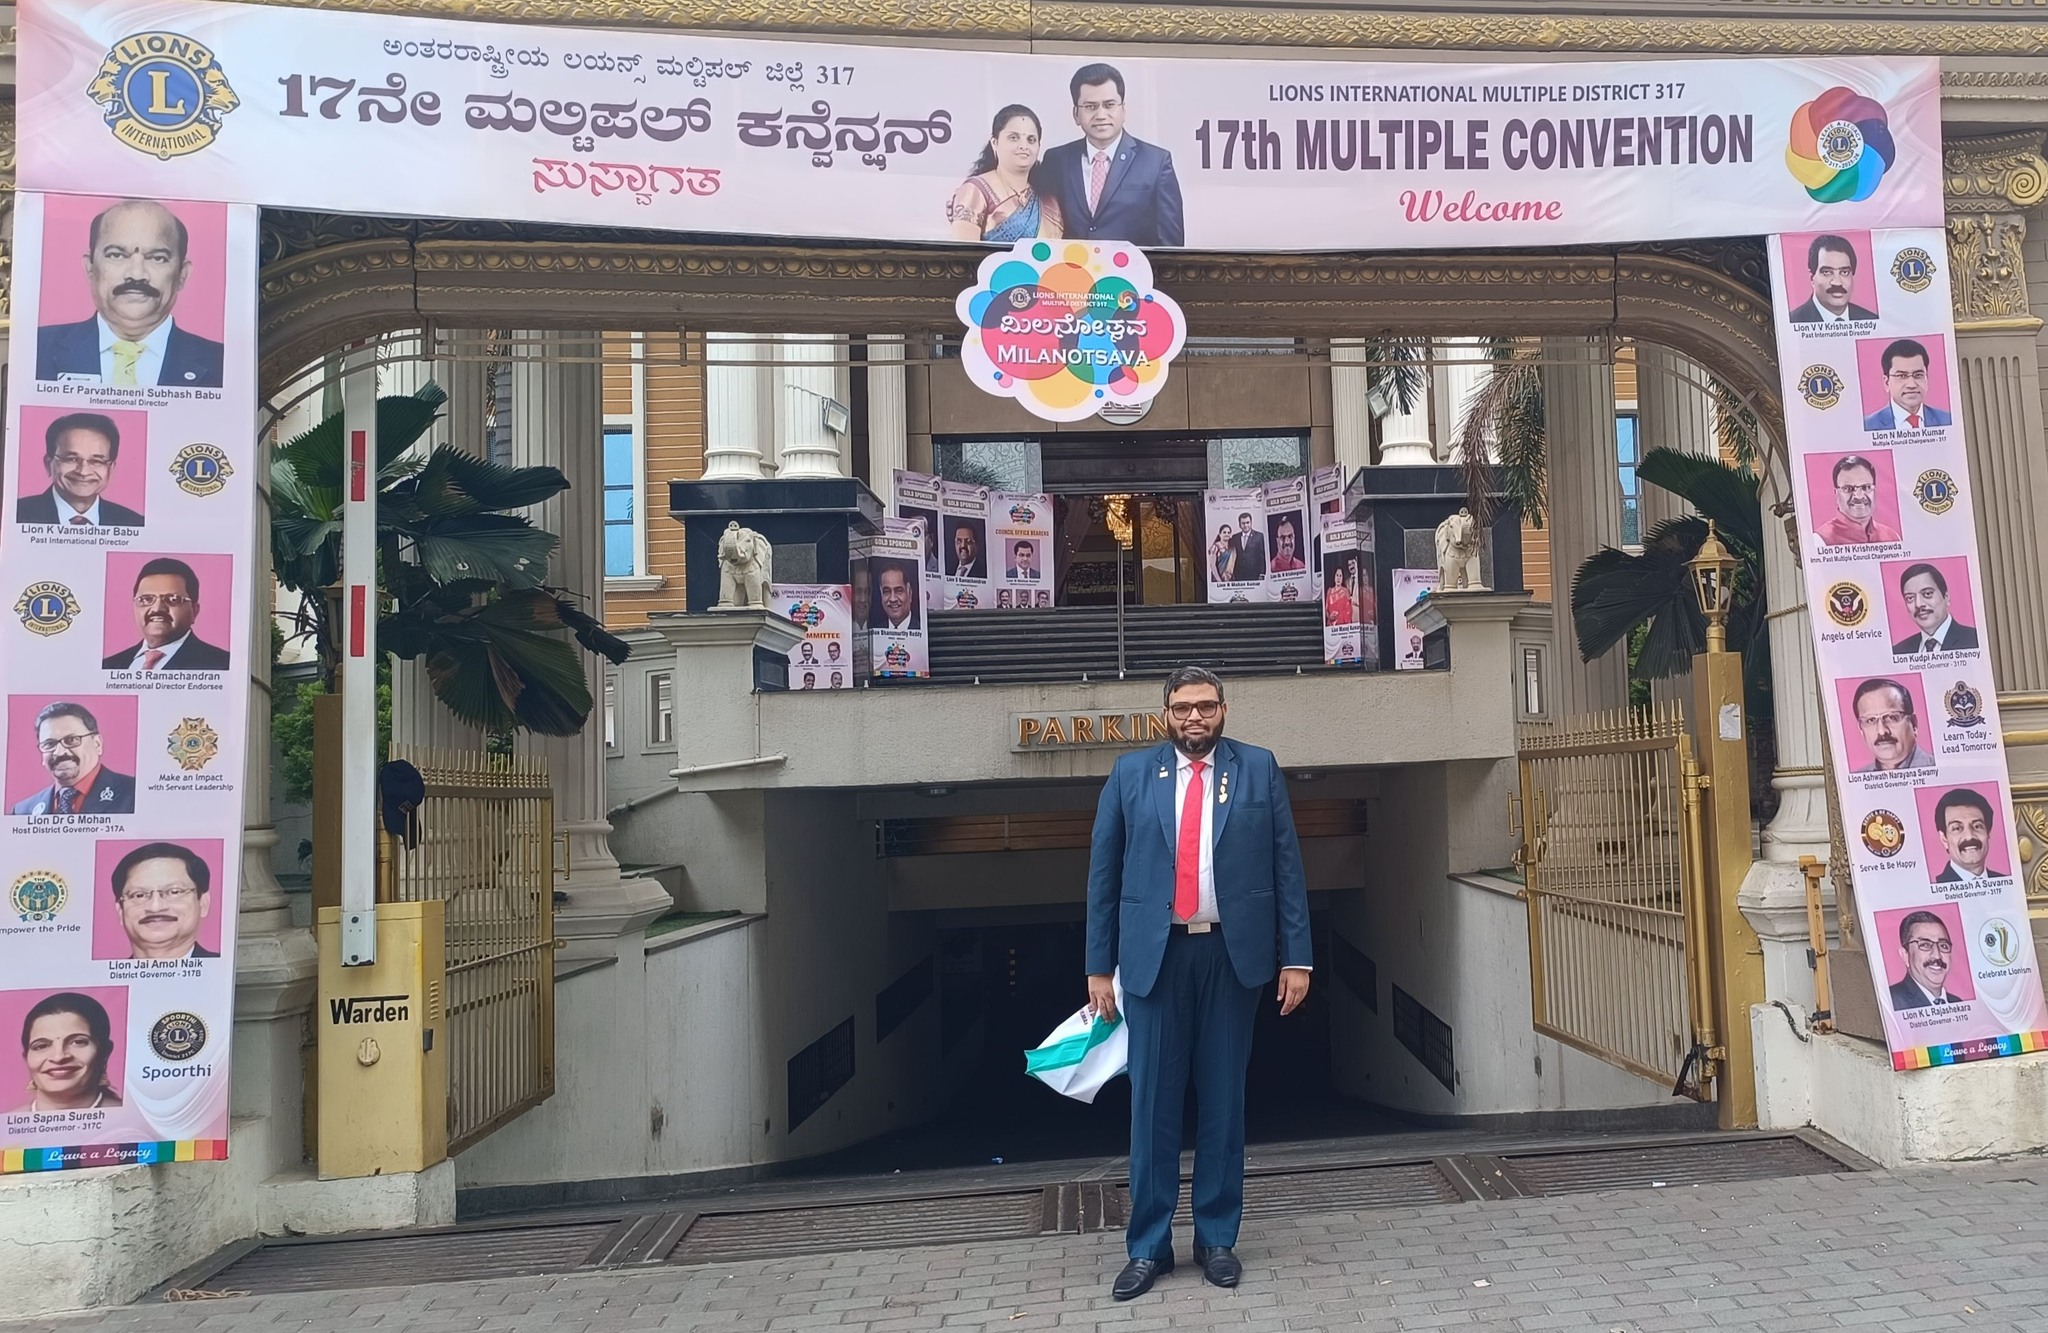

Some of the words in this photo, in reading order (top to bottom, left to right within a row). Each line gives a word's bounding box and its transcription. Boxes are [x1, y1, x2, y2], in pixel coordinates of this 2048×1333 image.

[120, 36, 206, 65] LIONS
[383, 38, 549, 78] ಅಂತರರಾಷ್ಟ್ರೀಯ
[564, 51, 646, 84] ಲಯನ್ಸ್
[657, 55, 752, 88] ಮಲ್ಟಿಪಲ್
[766, 62, 804, 92] ಜಿಲ್ಲೆ
[816, 66, 855, 85] 317
[148, 71, 186, 114] L
[1269, 85, 1324, 101] LIONS
[1330, 85, 1477, 102] INTERNATIONAL
[1483, 86, 1567, 102] MULTIPLE
[1573, 84, 1650, 101] DISTRICT
[1655, 83, 1685, 99] 317
[278, 72, 441, 126] 17ನೇ
[465, 90, 711, 152] ಮಲ್ಟಿಪಲ್
[121, 123, 206, 149] INTERNATIONAL
[1820, 124, 1834, 141] LEAVE
[1195, 119, 1281, 170] 17th
[1296, 119, 1489, 170] MULTIPLE
[1502, 114, 1753, 170] CONVENTION
[532, 157, 720, 206] ಸುಸ್ವಾಗತ
[1399, 190, 1563, 222] Welcome
[1900, 250, 1926, 259] LIONS
[1056, 292, 1115, 300] INTERNATIONAL
[1793, 323, 1809, 332] Lion
[1811, 323, 1816, 331] V
[1817, 322, 1823, 331] V
[1825, 321, 1853, 331] Krishna
[1854, 321, 1877, 331] Reddy
[997, 345, 1150, 366] MILANOTSAVA
[1806, 367, 1833, 376] LIONS
[37, 384, 59, 393] Lion
[63, 385, 74, 394] Er
[77, 386, 144, 397] Parvathaneni
[147, 388, 192, 399] Subhash
[195, 390, 221, 400] Babu
[90, 397, 137, 406] International
[138, 399, 168, 407] Director
[1872, 432, 1888, 440] Lion
[1890, 431, 1896, 439] N
[1899, 430, 1920, 438] Mohan
[1922, 429, 1945, 437] Kumar
[183, 446, 221, 458] LIONS
[1921, 471, 1947, 481] LIONS
[21, 525, 43, 534] Lion
[47, 526, 54, 534] K
[57, 526, 110, 536] Vamsidhar
[113, 527, 139, 536] Babu
[50, 537, 97, 545] International
[99, 538, 129, 546] Director
[875, 538, 887, 546] GOLD
[889, 540, 912, 548] SPONSOR
[1817, 547, 1833, 555] Lion
[1834, 546, 1843, 554] Dr
[1845, 545, 1850, 553] N
[1852, 543, 1902, 554] Krishnegowda
[29, 584, 67, 596] LIONS
[1821, 632, 1845, 643] Angels
[1847, 631, 1855, 640] of
[1856, 630, 1882, 639] Service
[1893, 656, 1908, 664] Lion
[1909, 653, 1930, 664] Kudpi
[1931, 651, 1953, 661] Arvind
[1955, 651, 1980, 660] Shenoy
[110, 671, 132, 680] Lion
[136, 671, 142, 680] S
[146, 671, 220, 681] Ramachandran
[106, 682, 154, 690] International
[156, 682, 185, 690] Director
[1018, 713, 1169, 746] PARKIN
[1944, 733, 1964, 741] Learn
[1966, 730, 1987, 741] Today
[1942, 745, 1960, 754] Lead
[1961, 743, 1997, 753] Tomorrow
[159, 774, 180, 782] Make
[195, 774, 223, 783] Impact
[1848, 775, 1861, 783] Lion
[1863, 772, 1889, 782] Ashwath
[1889, 770, 1917, 780] Narayana
[1918, 768, 1939, 779] Swamy
[195, 784, 233, 792] Leadership
[1885, 781, 1908, 789] Governor
[28, 816, 49, 825] Lion
[52, 816, 64, 825] Dr
[67, 816, 75, 824] G
[78, 816, 111, 824] Mohan
[105, 825, 125, 833] 317A
[1860, 864, 1879, 872] Serve
[1886, 862, 1895, 870] Be
[1896, 860, 1916, 870] Happy
[1930, 885, 1948, 894] Lion
[1949, 882, 1973, 891] Akash
[1975, 881, 1981, 889] A
[1983, 878, 2013, 889] Suvarna
[0, 926, 36, 935] mpower
[39, 925, 54, 933] the
[57, 924, 81, 932] Pride
[109, 960, 131, 970] Lion
[134, 959, 149, 969] Jai
[151, 959, 178, 969] Amol
[181, 958, 203, 968] Naik
[110, 971, 138, 979] District
[140, 971, 176, 979] Governor
[1978, 970, 2007, 980] Celebrate
[2008, 967, 2032, 976] Lionism
[330, 995, 409, 1025] Warden
[1902, 1010, 1918, 1020] Lion
[1919, 1010, 1924, 1018] K
[1925, 1009, 1930, 1017] L
[1931, 1003, 1971, 1017] Rajashekara
[161, 1014, 197, 1025] SPOORTHI
[1944, 1046, 1967, 1058] Leave
[1978, 1041, 2008, 1053] Legacy
[142, 1064, 212, 1081] Spoorthi
[7, 1115, 30, 1125] Lion
[33, 1113, 66, 1125] Sapna
[69, 1110, 105, 1121] Suresh
[8, 1127, 37, 1135] District
[39, 1124, 76, 1133] Governor
[82, 1122, 102, 1130] 317C
[47, 1150, 86, 1162] Leave
[90, 1151, 100, 1159] a
[103, 1147, 152, 1161] Legacy
